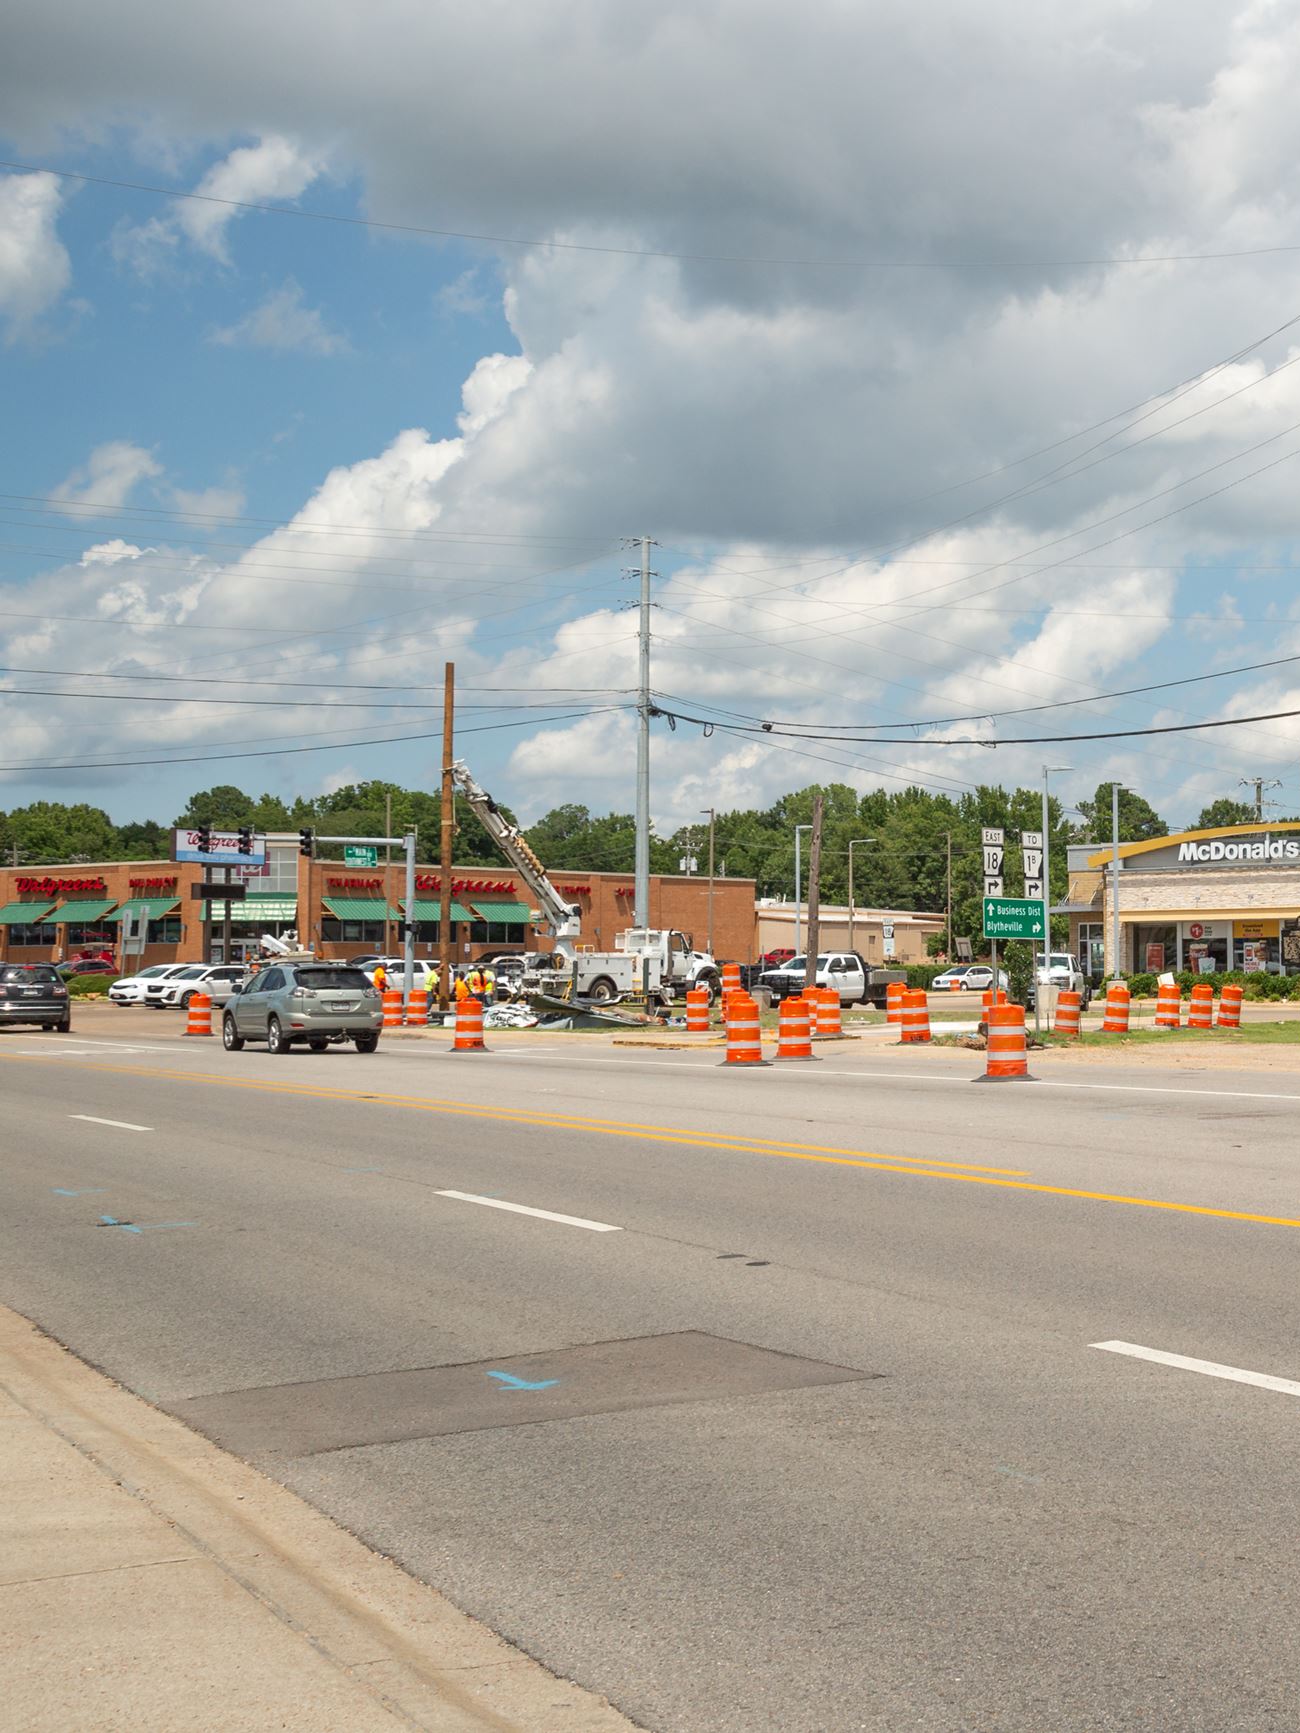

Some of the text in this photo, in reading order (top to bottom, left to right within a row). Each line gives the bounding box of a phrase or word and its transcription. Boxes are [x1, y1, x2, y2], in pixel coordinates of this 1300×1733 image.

[985, 831, 1000, 842] EAST
[1028, 835, 1038, 845] TO
[1178, 839, 1300, 861] McDonald's
[987, 852, 998, 870] 18
[327, 878, 384, 889] PHARMACY
[415, 874, 517, 897] Wagreens
[997, 904, 1041, 917] Business Dist
[986, 921, 1023, 934] Blytheville
